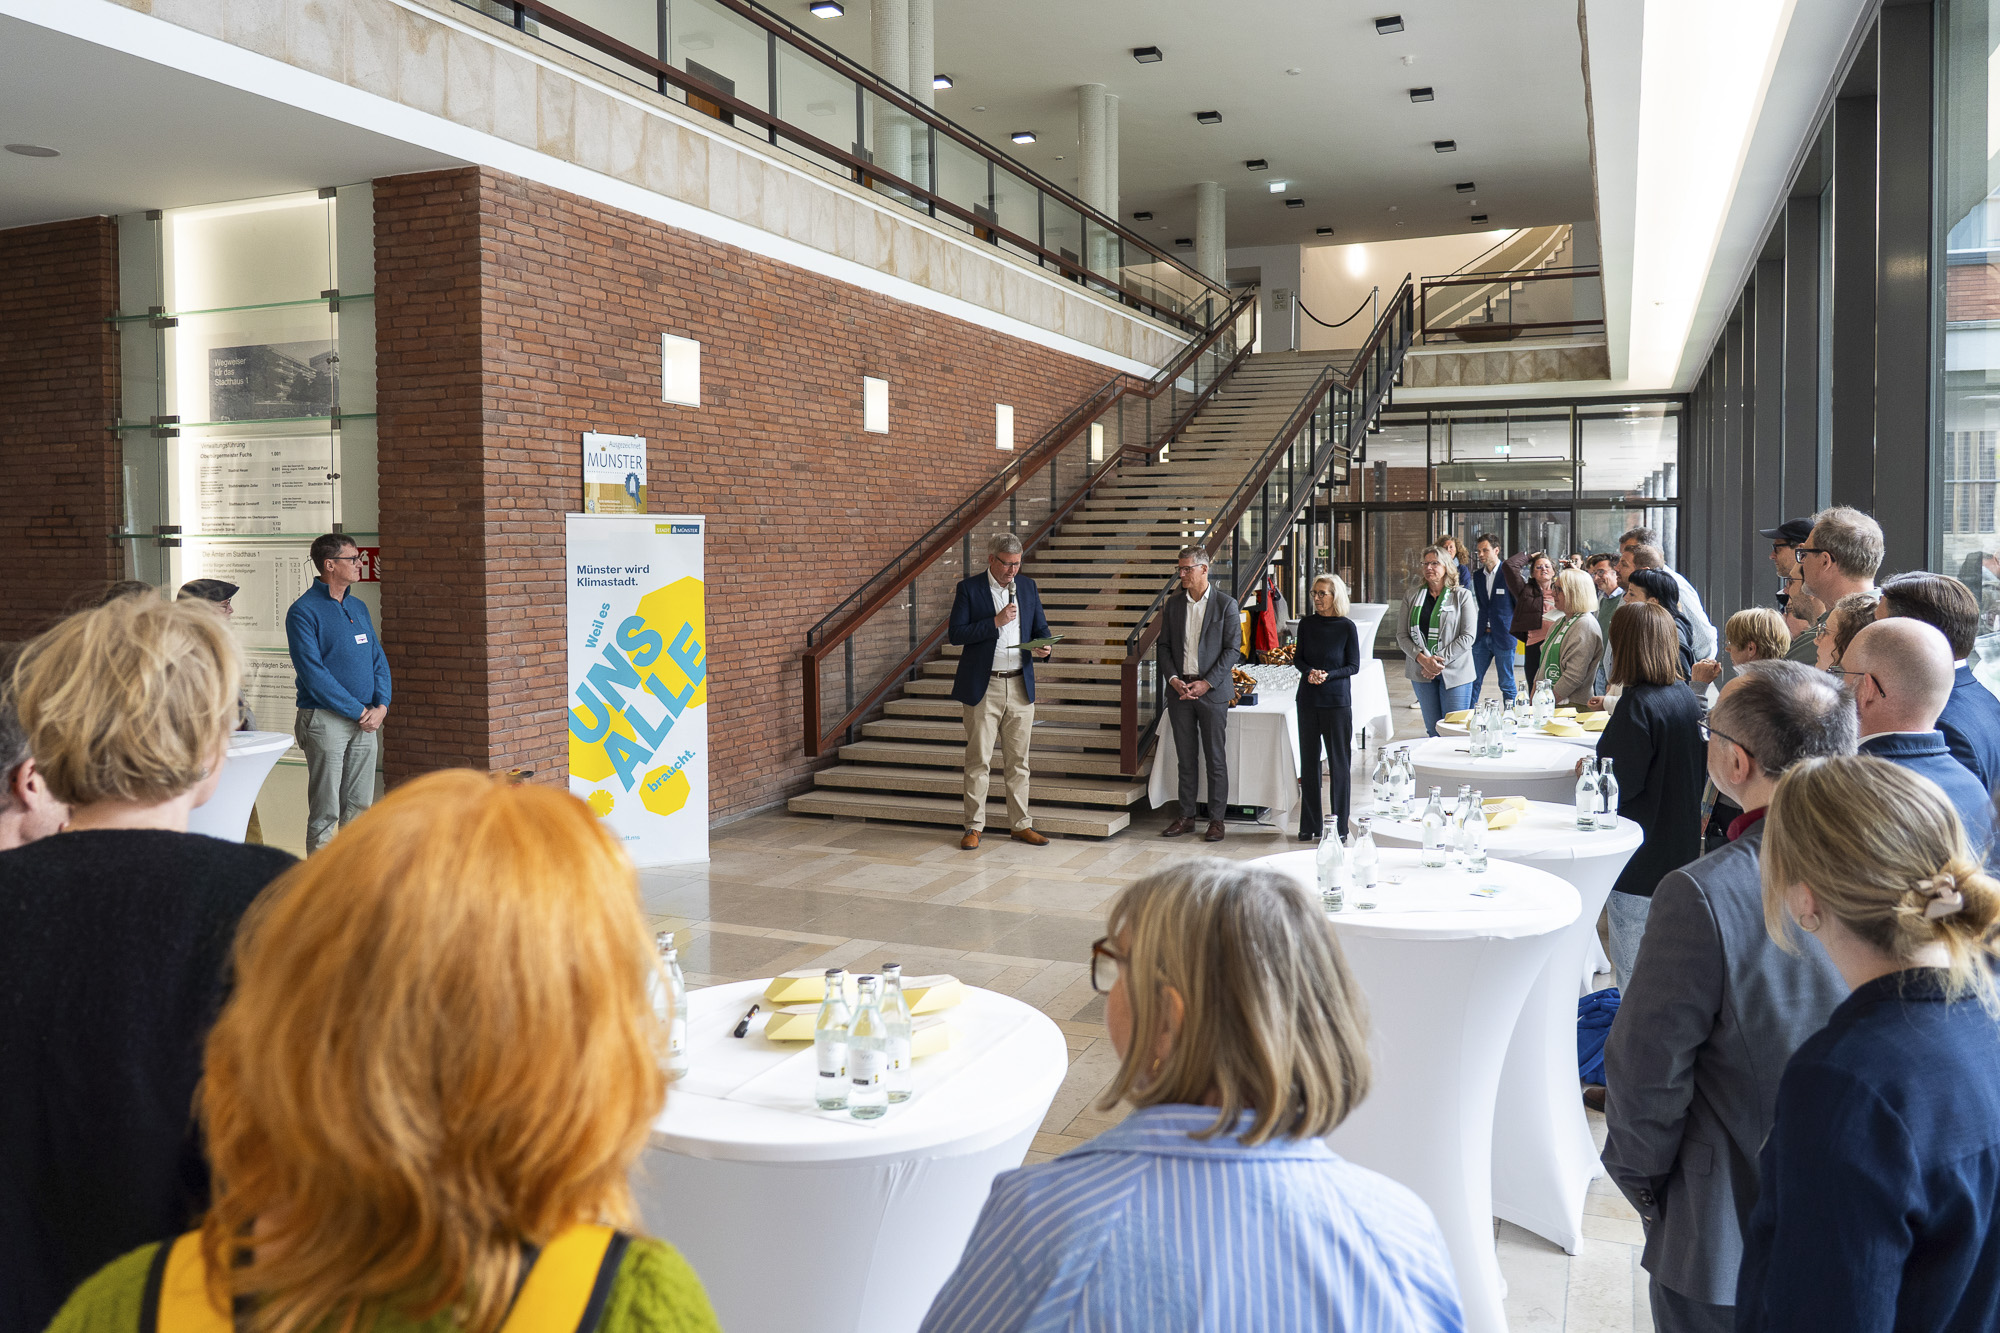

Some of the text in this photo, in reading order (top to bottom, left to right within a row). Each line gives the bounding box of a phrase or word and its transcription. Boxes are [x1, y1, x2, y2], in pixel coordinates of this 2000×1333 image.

[214, 358, 246, 367] Wegweiser
[214, 367, 235, 376] für das
[214, 376, 249, 386] Stadthaus 1
[577, 564, 650, 574] Münster wird
[577, 577, 638, 587] Klimastadt.
[585, 602, 611, 649] Weil es
[568, 615, 663, 744] UNS
[603, 621, 706, 793] ALLE
[647, 749, 696, 793] braucht.
